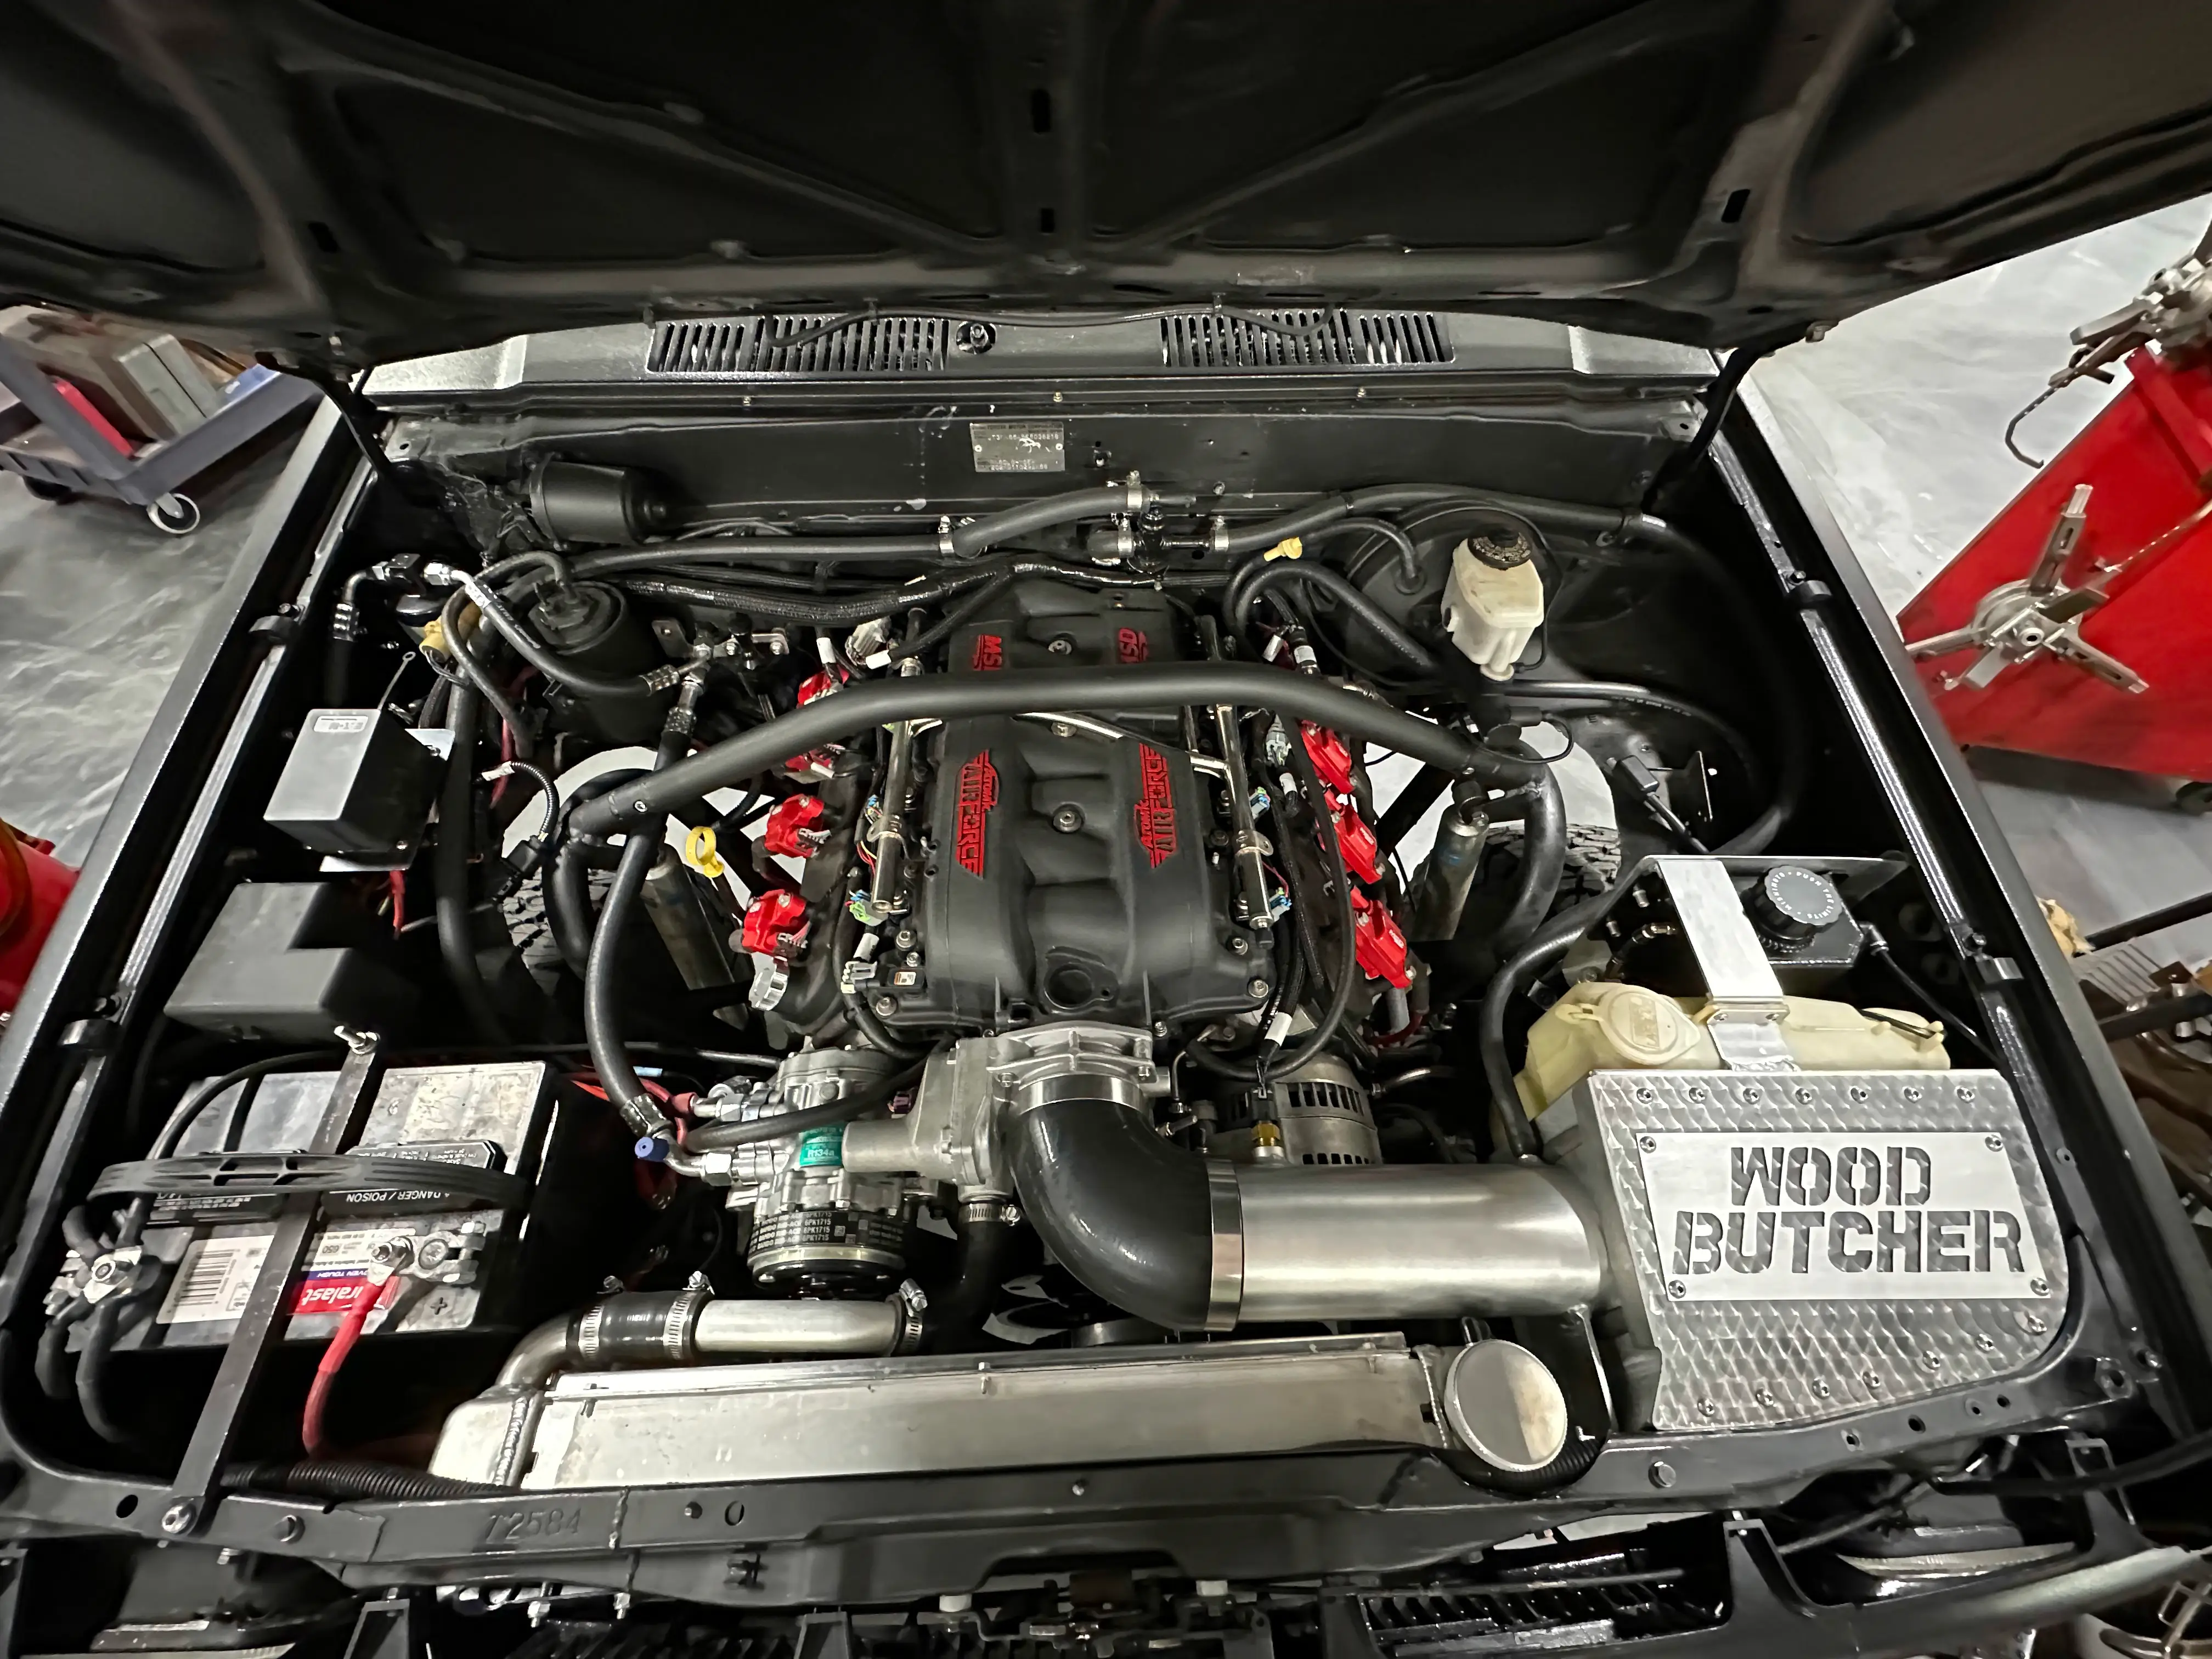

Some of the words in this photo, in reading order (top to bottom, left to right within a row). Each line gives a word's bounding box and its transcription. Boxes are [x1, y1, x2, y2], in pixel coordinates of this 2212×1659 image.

[983, 635, 1002, 671] MS
[1730, 1146, 1932, 1207] WOOD
[346, 1192, 387, 1203] POISON
[1672, 1210, 2027, 1275] BUTCHER
[302, 1286, 364, 1306] ralast
[485, 1508, 582, 1542] 72584
